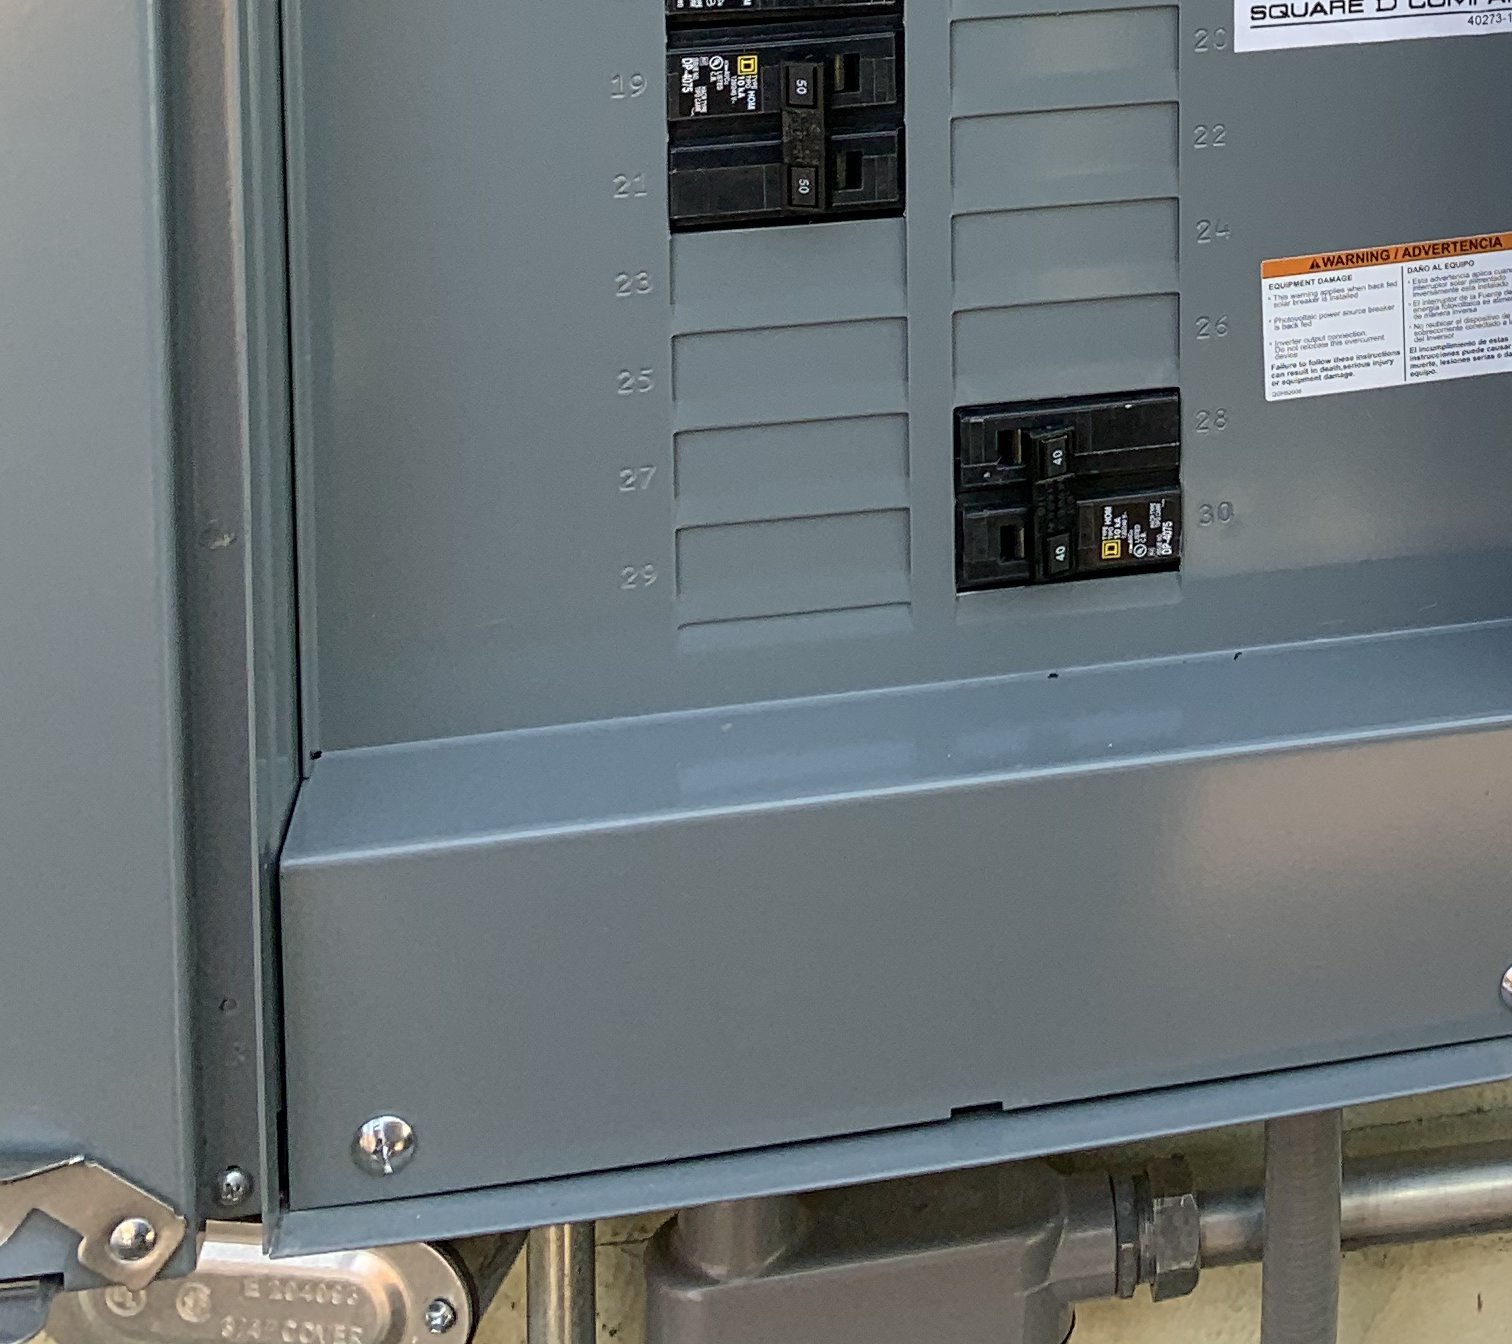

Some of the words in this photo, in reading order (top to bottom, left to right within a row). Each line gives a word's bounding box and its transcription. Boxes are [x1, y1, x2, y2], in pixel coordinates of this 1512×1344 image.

[797, 80, 807, 94] 50
[1193, 125, 1228, 147] 22
[799, 179, 809, 193] 50
[1321, 249, 1391, 268] WARNING
[1401, 236, 1503, 259] ADVERTENCIA
[1407, 264, 1431, 274] DAÑO
[1431, 263, 1443, 271] AL
[1444, 259, 1475, 270] EQUIPO
[1268, 278, 1316, 291] EQUIPMENT
[1317, 274, 1353, 285] DAMAGE
[1196, 317, 1229, 338] 26
[617, 371, 655, 394] 25
[1053, 450, 1062, 465] 40
[1056, 546, 1065, 560] 40
